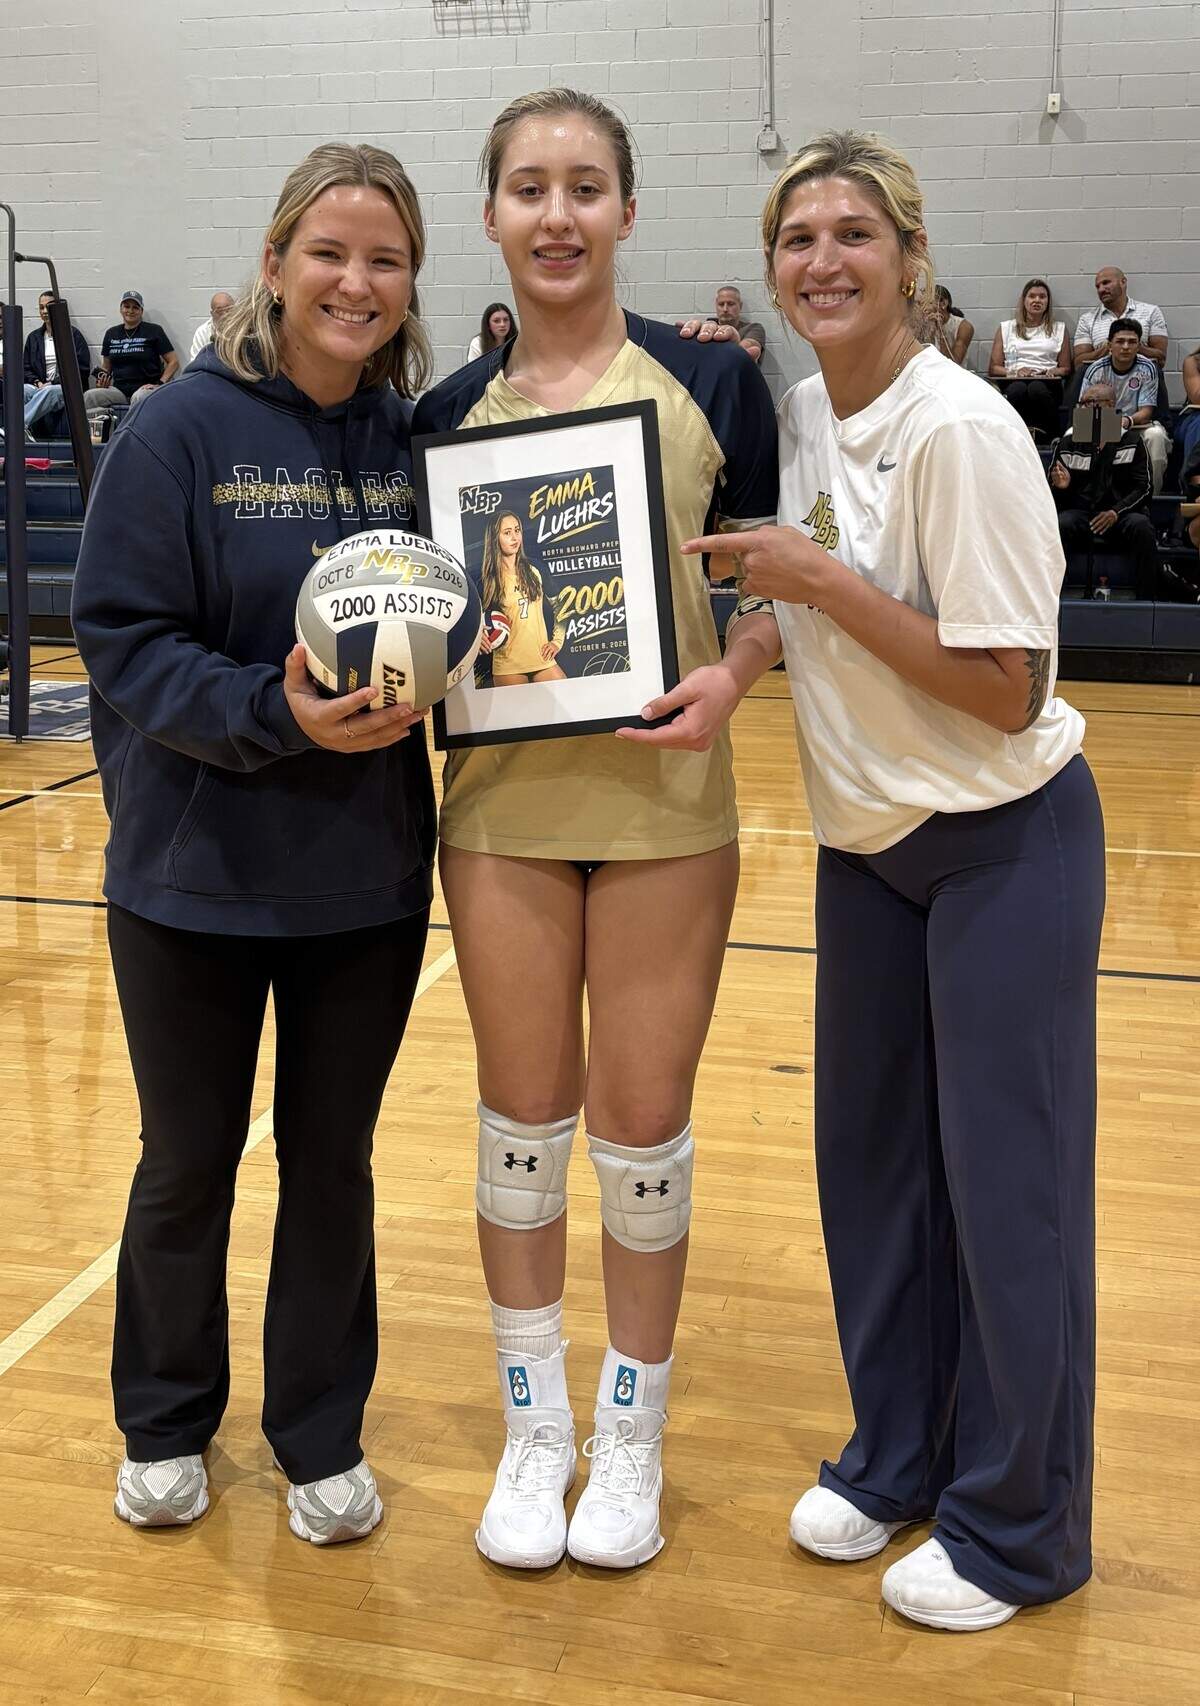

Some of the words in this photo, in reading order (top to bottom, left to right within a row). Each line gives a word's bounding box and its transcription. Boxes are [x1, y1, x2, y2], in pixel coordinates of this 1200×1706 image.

[233, 464, 412, 520] EAGLES
[458, 486, 502, 515] NBP
[528, 472, 598, 520] EMMA
[536, 491, 614, 544] LUEHRS
[800, 491, 840, 552] NBP
[328, 535, 382, 562] EMMA
[389, 534, 453, 563] LUEHRS
[542, 548, 564, 557] NORTH
[566, 543, 599, 554] BROWARD
[601, 540, 619, 549] PREP
[318, 568, 345, 590] OCT
[345, 564, 354, 579] 8
[358, 548, 430, 586] NBP
[433, 565, 463, 589] 2026
[548, 553, 622, 574] VOLLEYBALL
[330, 595, 376, 622] 2000
[384, 593, 453, 619] ASSISTS
[518, 597, 529, 619] 7
[556, 576, 624, 622] 2000
[566, 606, 626, 639] ASSISTS
[570, 643, 600, 653] OCTOBER
[609, 640, 627, 649] 2026
